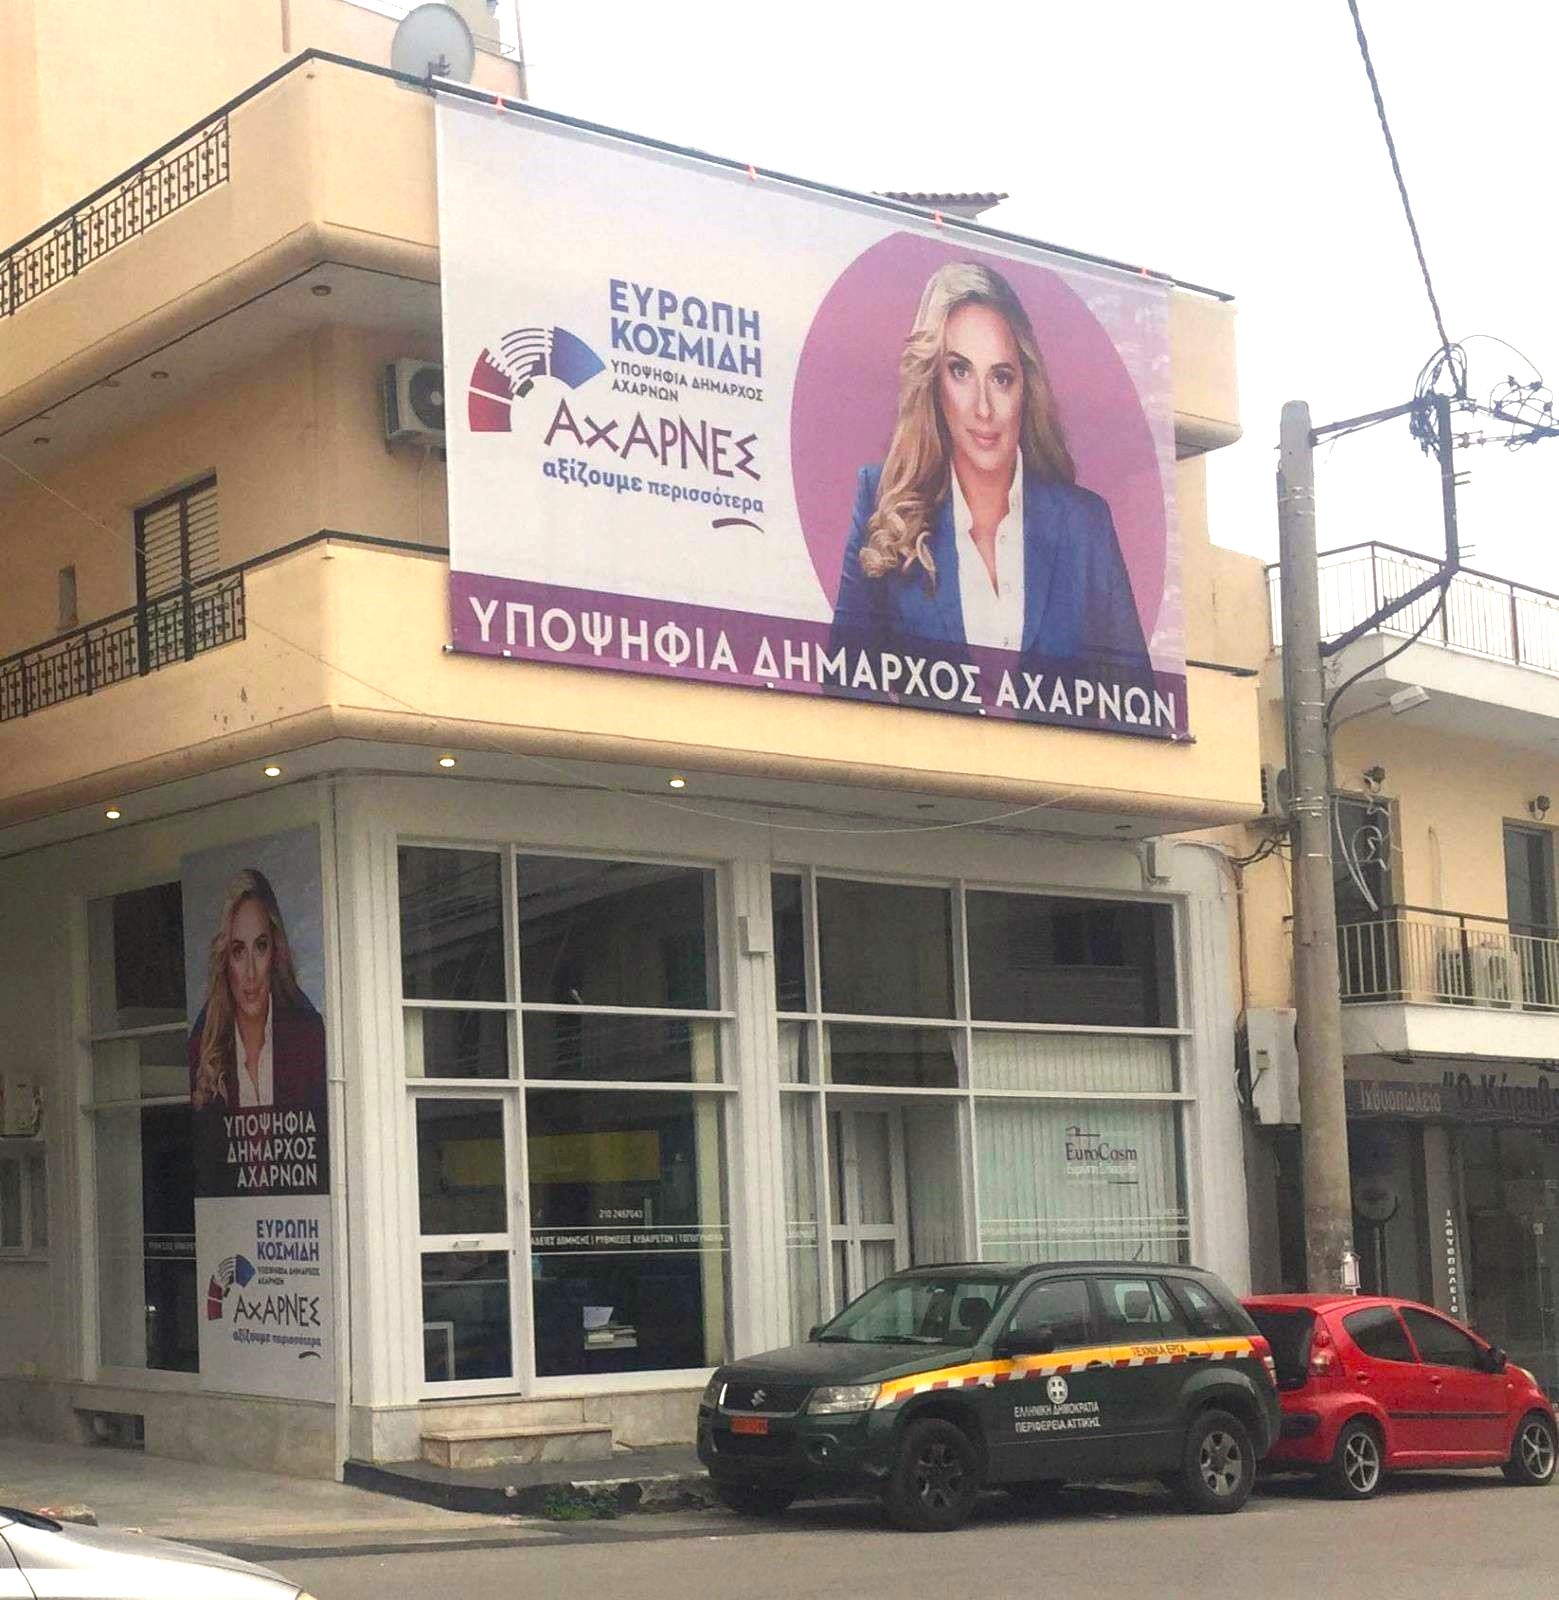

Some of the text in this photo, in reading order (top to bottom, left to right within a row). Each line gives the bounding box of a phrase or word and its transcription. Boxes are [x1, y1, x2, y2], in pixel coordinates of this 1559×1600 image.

[609, 278, 760, 341] ΕΥΡΩΠΗ
[611, 317, 762, 378] ΚΟΣΜΙΔΗ
[610, 359, 763, 402] ΥΠΟΨΗΦΙΑ ΔΗΜΑΡΧΟΣ
[612, 381, 679, 402] ΑΧΑΡΝΩΝ
[542, 457, 764, 514] αξίζουμε περισσότερα
[469, 596, 1176, 729] ΥΠΟΨΗΦΙΑ ΔΗΜΑΡΧΟΣ ΑΧΑΡΝΩΝ
[223, 1110, 317, 1138] ΥΠΟΨΗΦΙΑ
[227, 1137, 317, 1163] ΔΗΜΑΡΧΟΣ
[237, 1163, 318, 1188] ΑΧΑΡΝΩΝ
[256, 1219, 319, 1239] ΕΥΡΩΠΗ
[257, 1241, 319, 1261] ΚΟΣΜΙΔΗ
